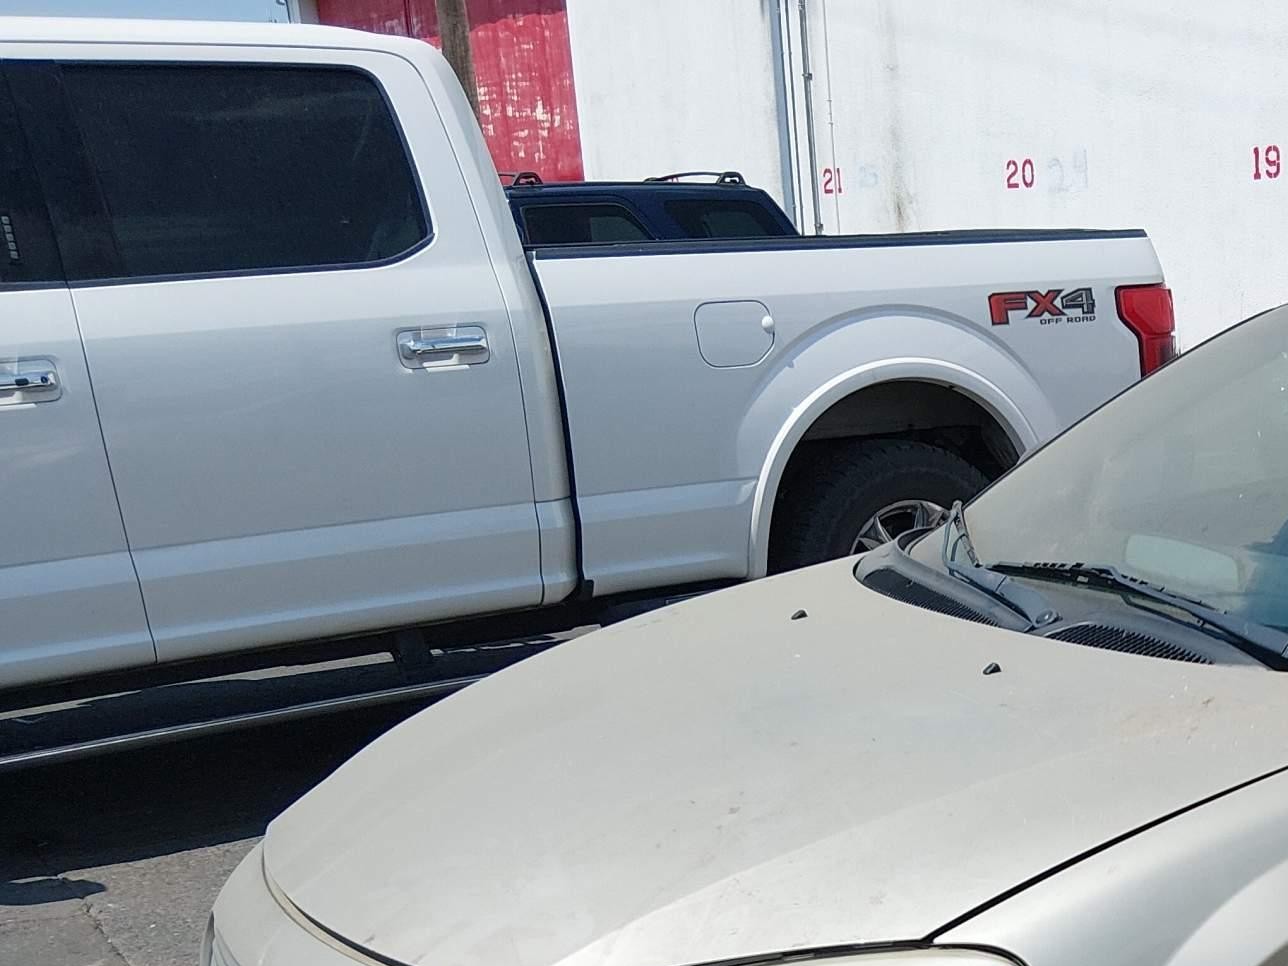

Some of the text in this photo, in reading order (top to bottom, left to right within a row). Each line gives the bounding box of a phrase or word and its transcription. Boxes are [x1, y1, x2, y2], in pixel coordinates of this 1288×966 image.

[1006, 158, 1034, 189] 20
[1253, 145, 1281, 180] 19
[823, 167, 842, 194] 21
[988, 287, 1096, 326] FX4
[1039, 315, 1096, 325] OFF ROAD
